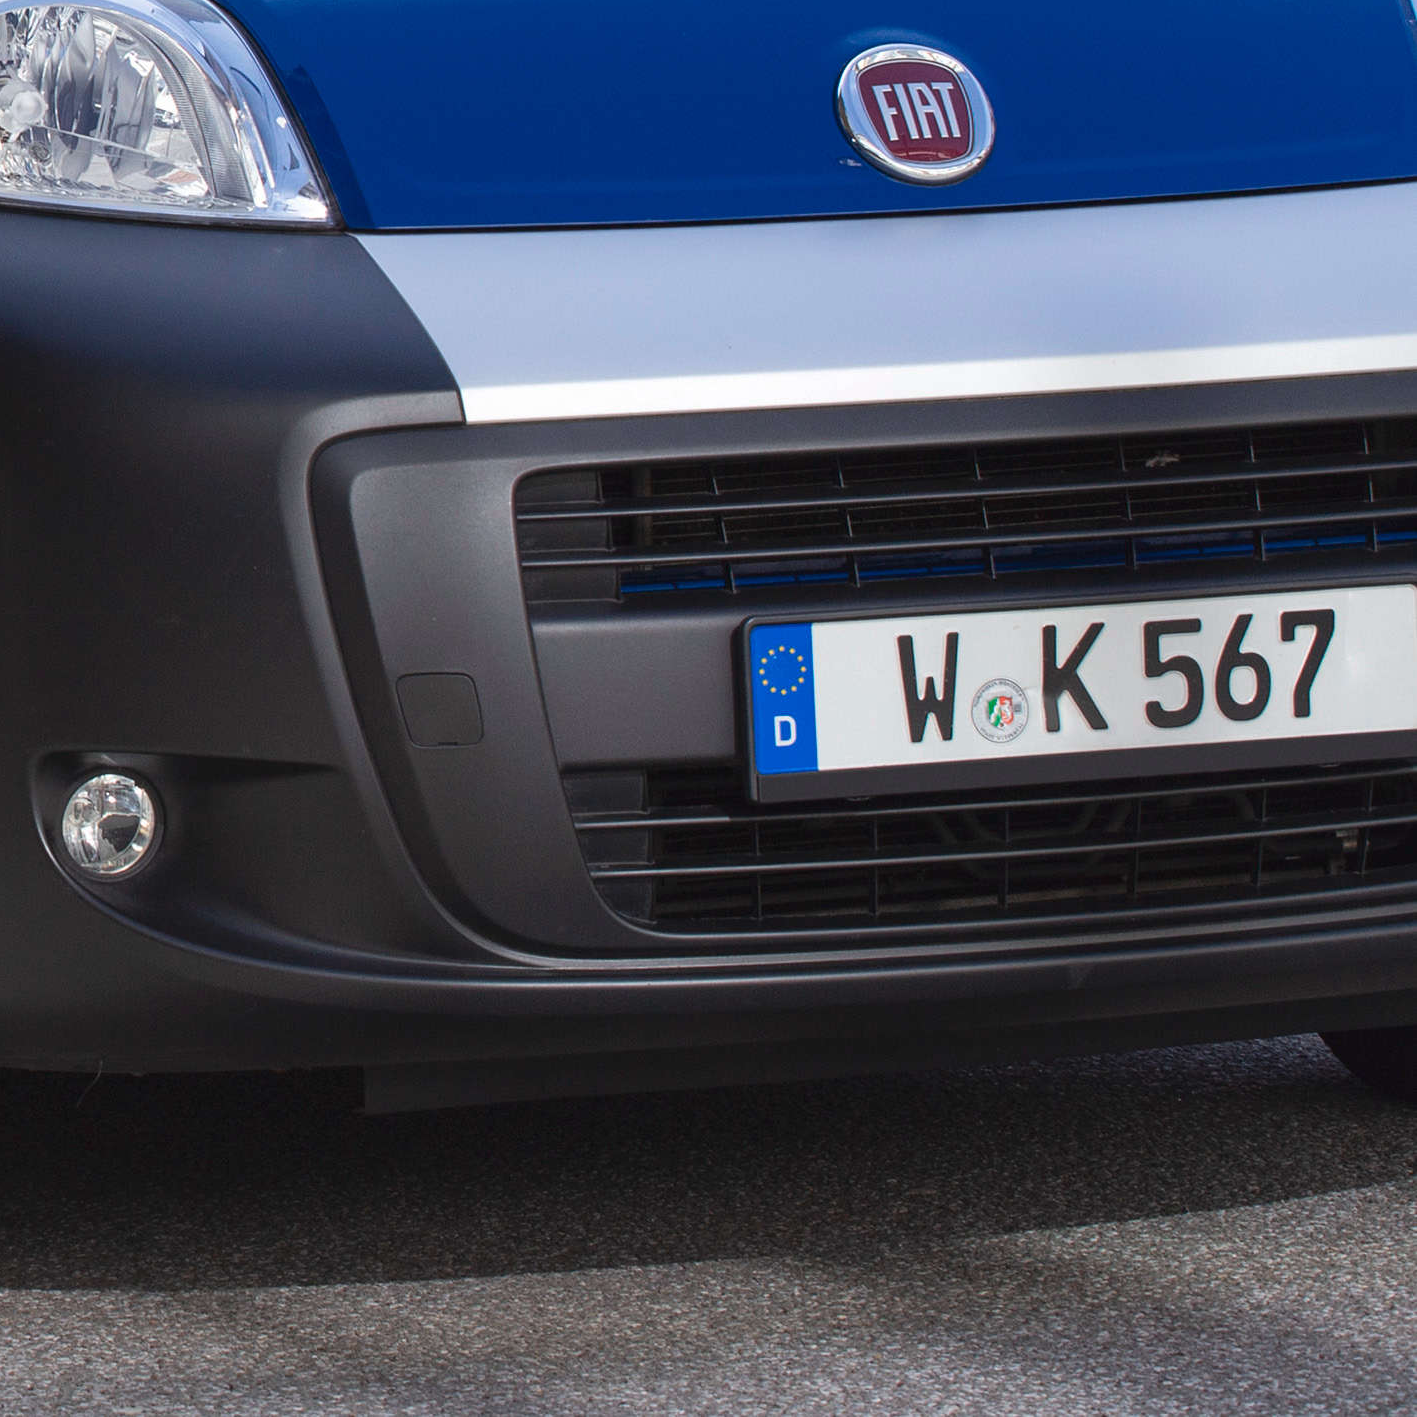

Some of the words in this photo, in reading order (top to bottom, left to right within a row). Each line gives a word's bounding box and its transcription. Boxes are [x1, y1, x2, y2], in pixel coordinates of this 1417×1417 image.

[871, 82, 962, 142] FIAT
[897, 632, 960, 744] W
[1042, 621, 1109, 733] K
[1144, 608, 1337, 730] 567
[774, 715, 797, 747] D
